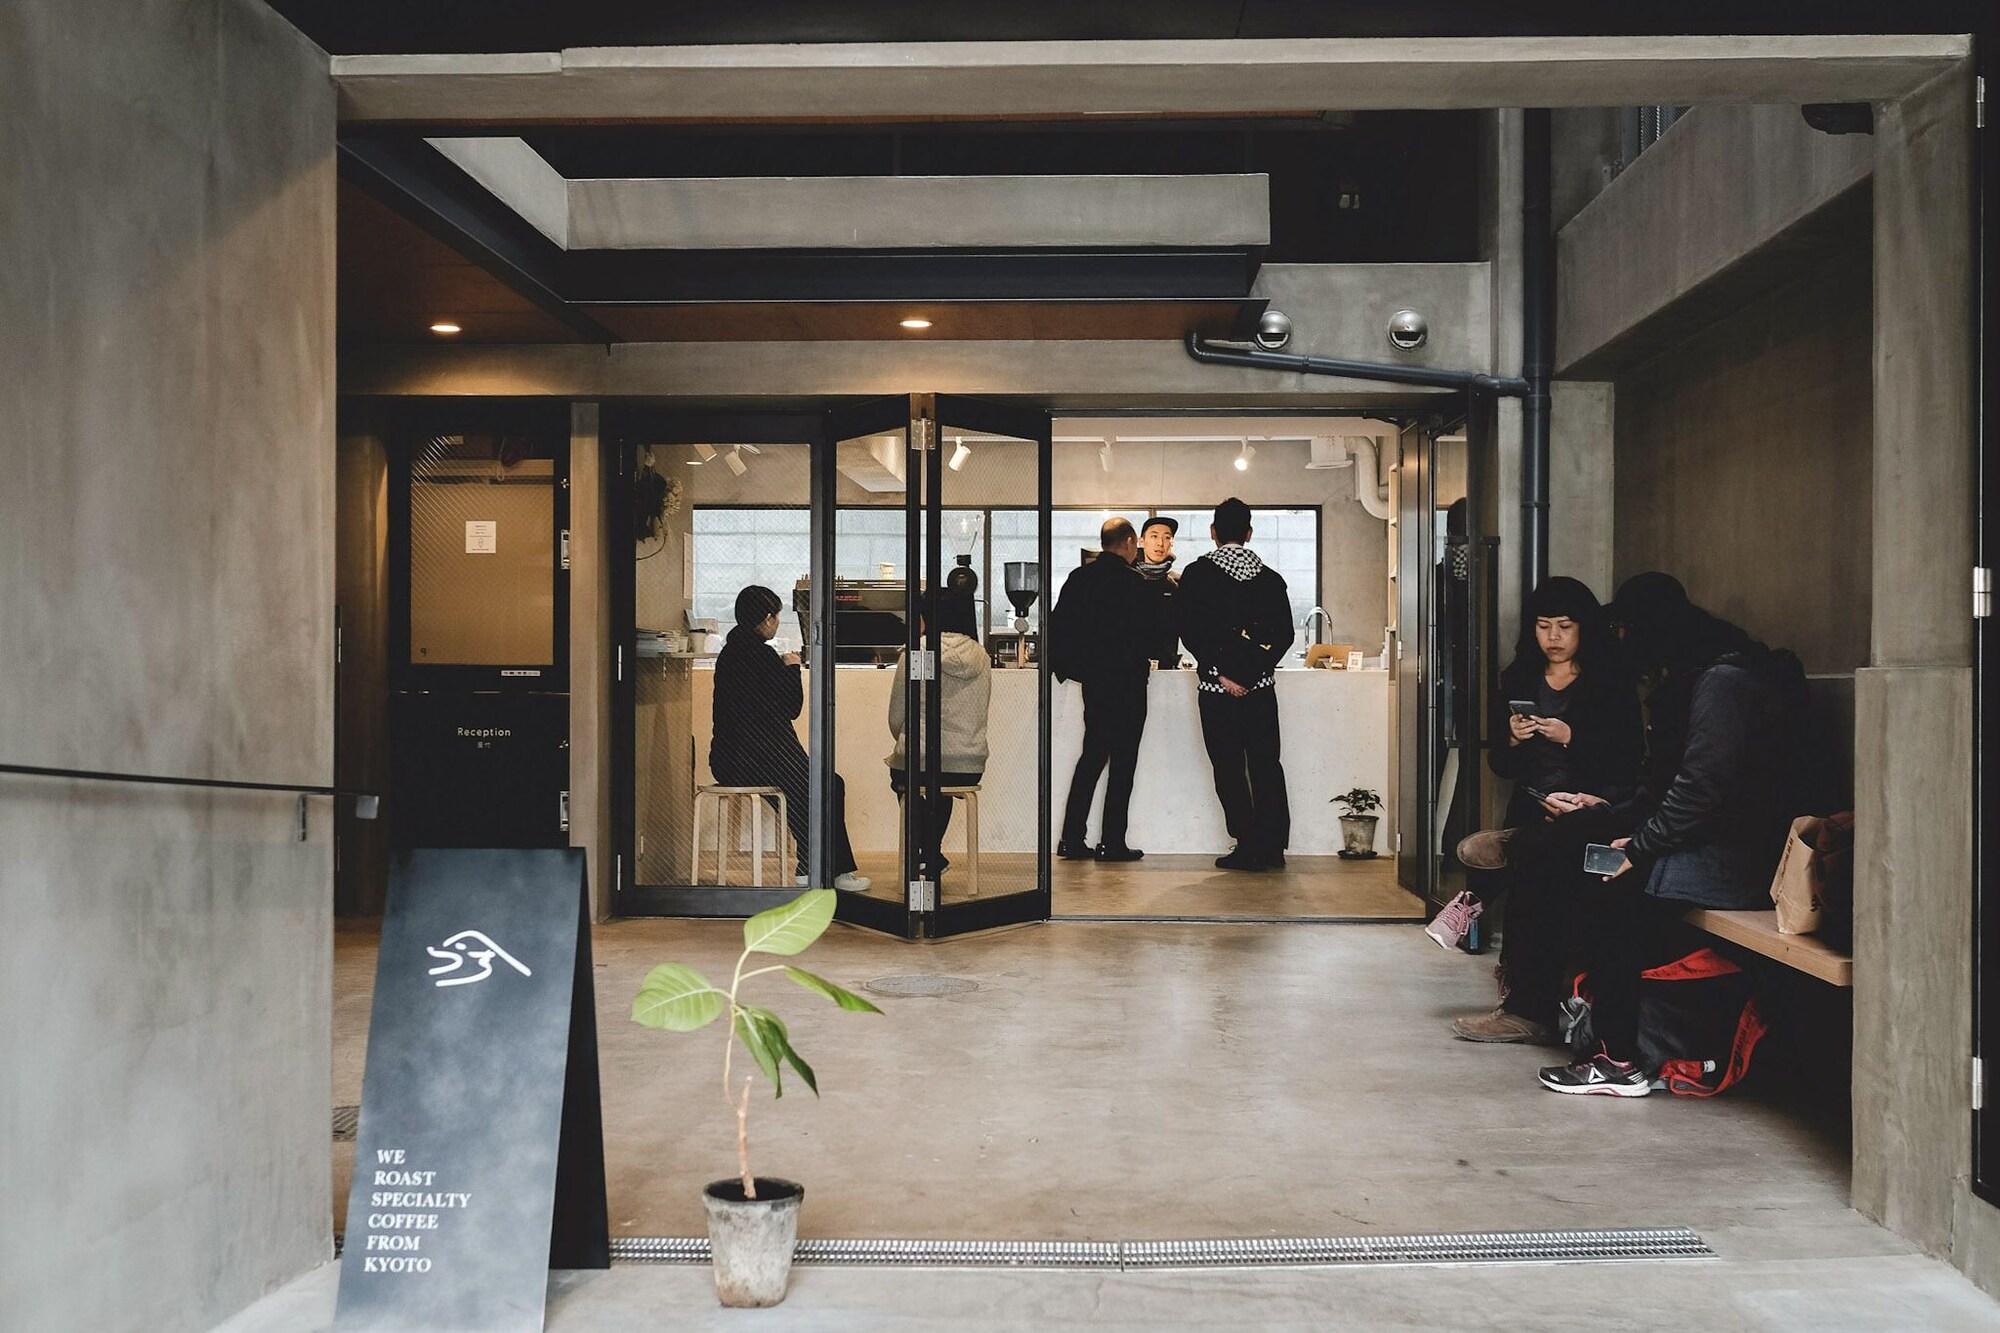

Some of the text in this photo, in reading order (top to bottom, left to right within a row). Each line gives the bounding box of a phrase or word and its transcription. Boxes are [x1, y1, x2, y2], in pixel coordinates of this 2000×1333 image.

[457, 727, 511, 738] Reception
[376, 1149, 406, 1165] WE
[374, 1170, 436, 1186] ROAST
[371, 1192, 472, 1208] SPECIALTY
[368, 1213, 439, 1229] COFFEE
[366, 1235, 420, 1251] FROM
[364, 1257, 432, 1273] KYOTO
